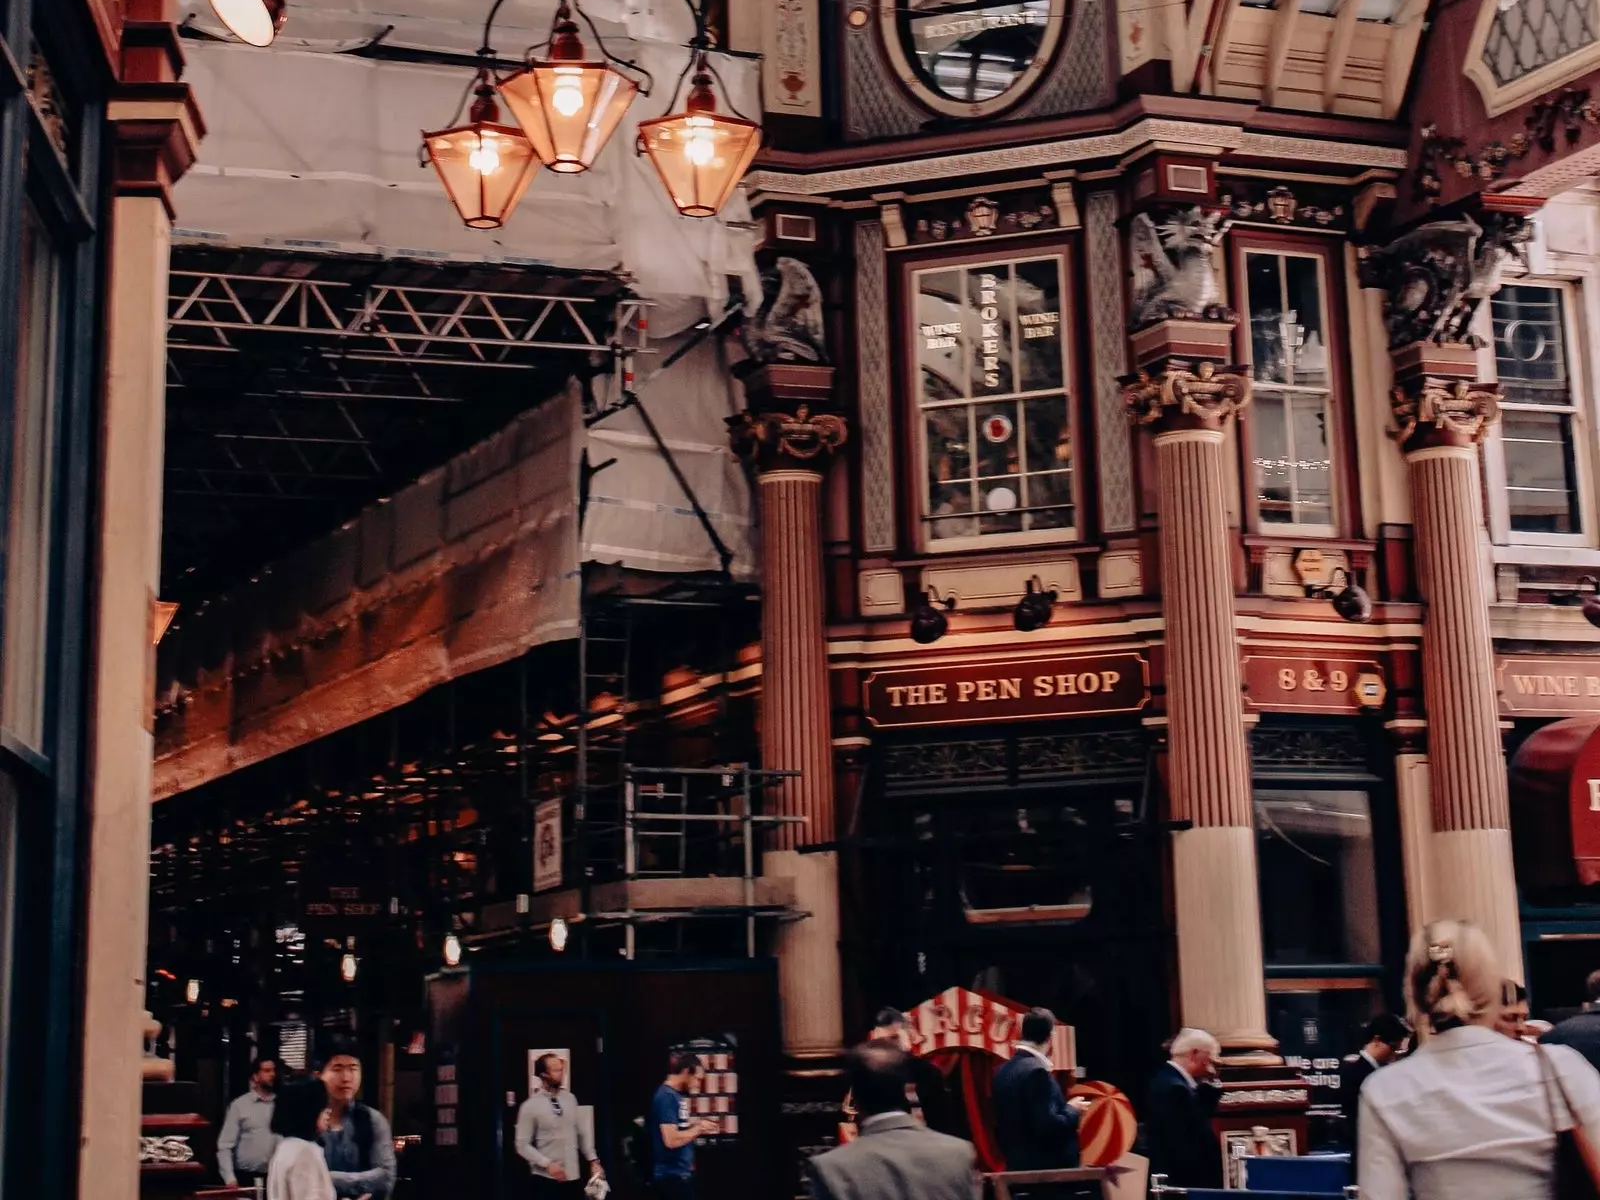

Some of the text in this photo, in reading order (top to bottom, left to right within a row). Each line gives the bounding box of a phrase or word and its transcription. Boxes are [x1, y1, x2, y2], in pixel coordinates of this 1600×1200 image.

[1019, 312, 1060, 326] WINE
[921, 323, 962, 337] WINE
[980, 273, 999, 388] BROKERS
[1024, 326, 1055, 339] BAR
[926, 337, 957, 350] BAR
[1278, 668, 1349, 692] 8 & 9
[1511, 674, 1579, 697] WINE
[886, 671, 1121, 707] THE PEN SHOP
[1313, 1056, 1340, 1070] are
